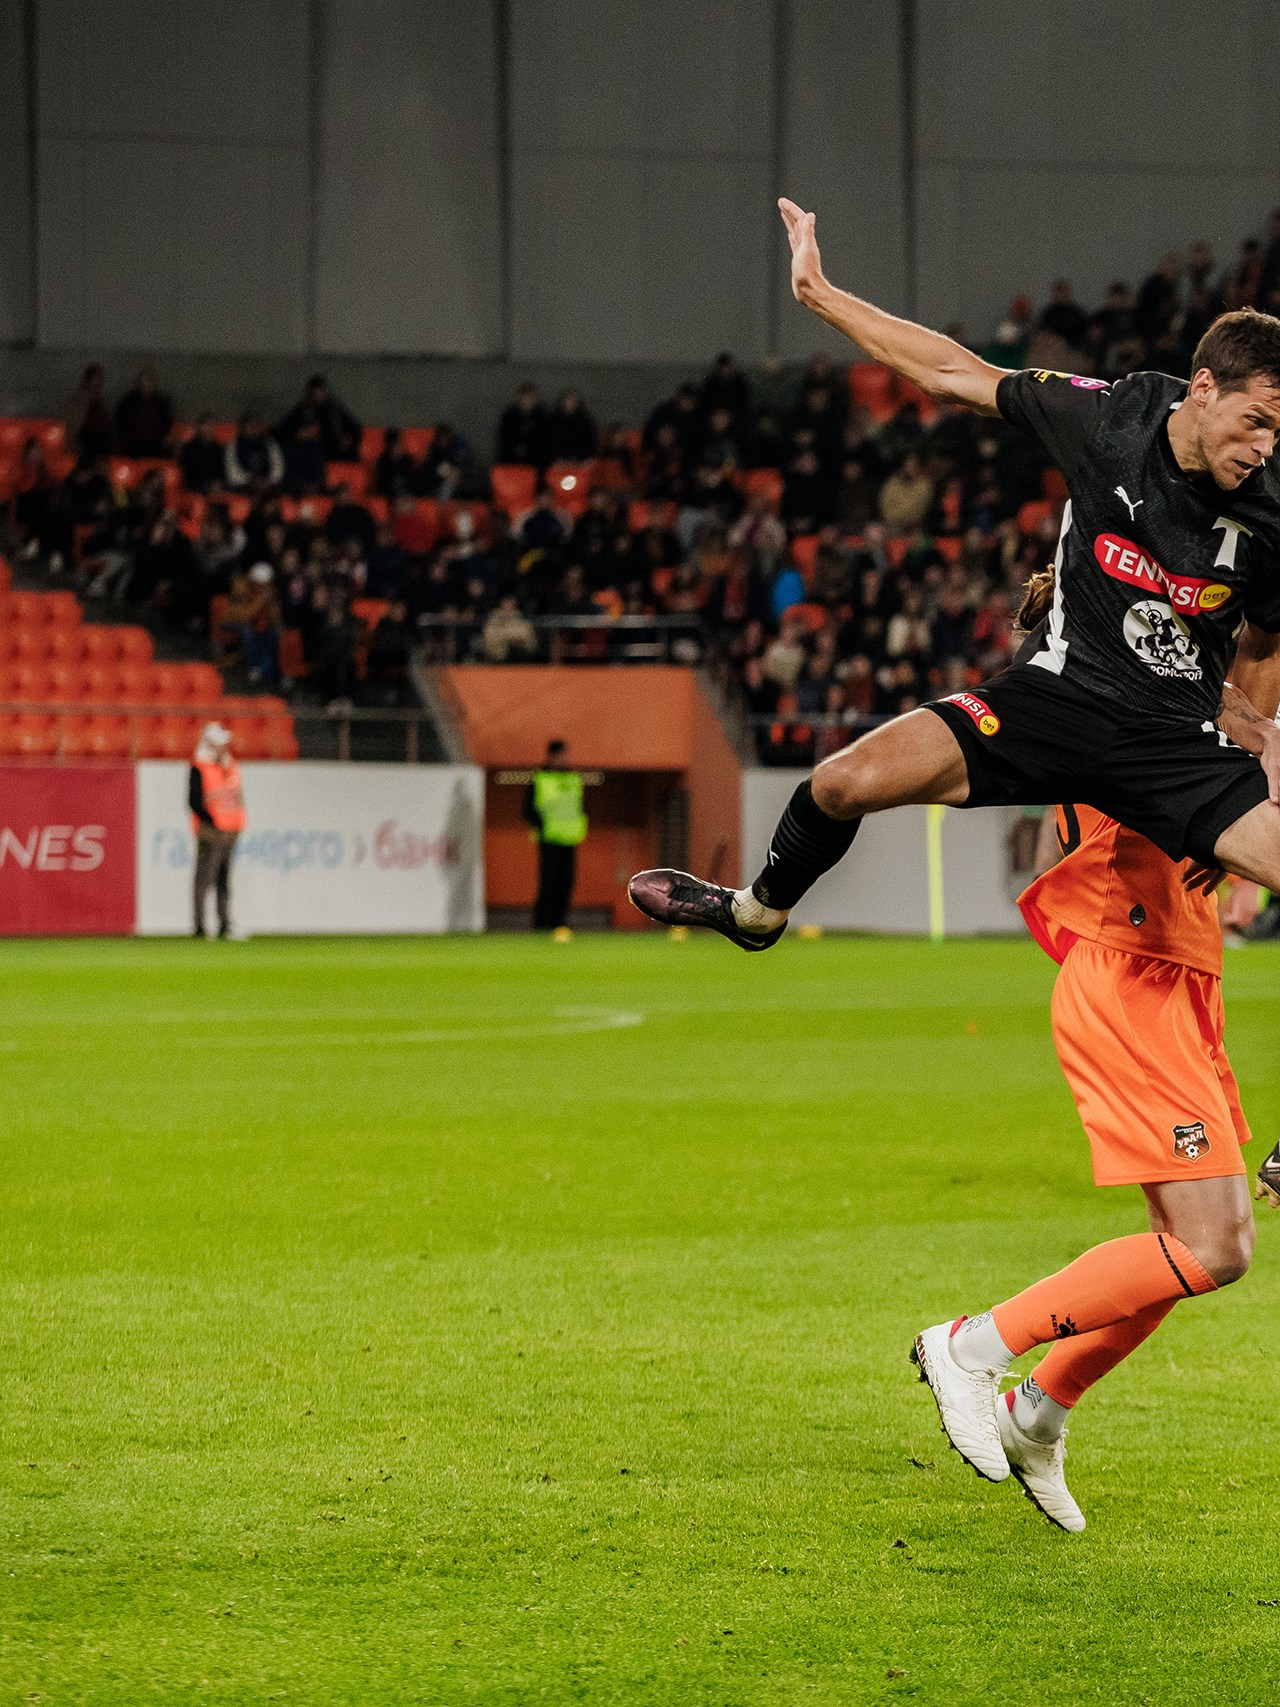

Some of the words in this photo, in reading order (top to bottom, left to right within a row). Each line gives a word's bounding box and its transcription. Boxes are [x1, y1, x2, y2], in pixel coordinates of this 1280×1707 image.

[1203, 590, 1228, 601] bet
[982, 719, 995, 731] bet
[1176, 1130, 1204, 1148] УРАЛ
